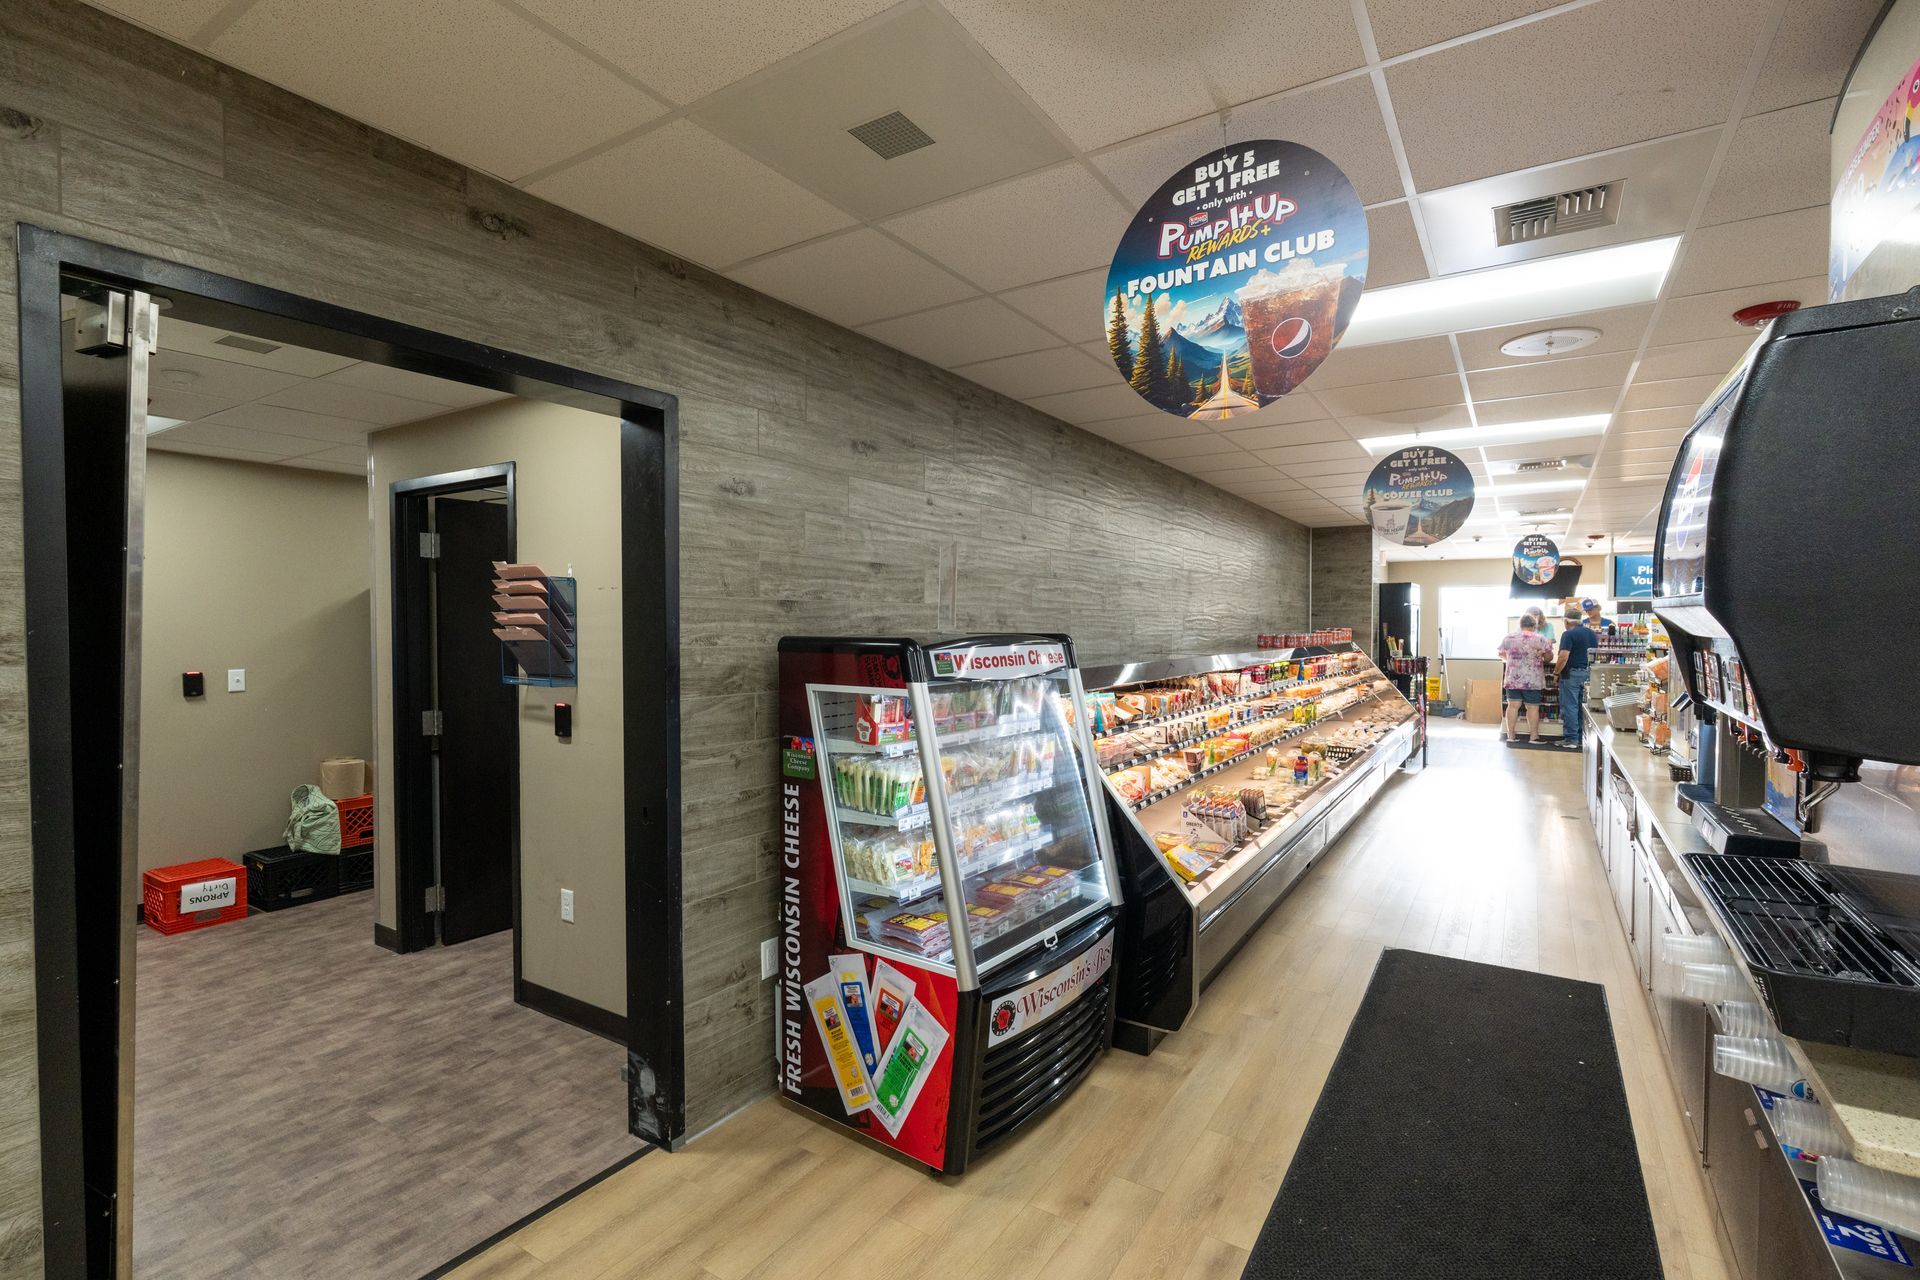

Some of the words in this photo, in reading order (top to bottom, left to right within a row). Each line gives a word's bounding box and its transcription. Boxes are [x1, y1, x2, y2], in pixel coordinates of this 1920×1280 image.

[1172, 182, 1210, 206] GET
[1215, 177, 1224, 193] 1
[1230, 159, 1280, 190] FREE
[1195, 155, 1239, 183] BUY
[1243, 150, 1255, 168] 5
[1202, 198, 1223, 210] only
[1225, 190, 1247, 203] with
[1127, 248, 1257, 298] FOUNTAIN
[1263, 229, 1335, 262] CLUB
[1390, 459, 1410, 468] GET
[1420, 456, 1447, 465] FREE
[1402, 450, 1425, 459] BUY
[1428, 449, 1434, 457] 5
[1383, 490, 1422, 499] COFFEE
[1425, 488, 1453, 497] CLUB
[784, 783, 800, 869] CHEESE
[189, 891, 229, 904] APRONS
[784, 877, 801, 1011] WISCONSIN
[1017, 959, 1091, 1017] Wisconsin's
[786, 1019, 802, 1095] FRESH
